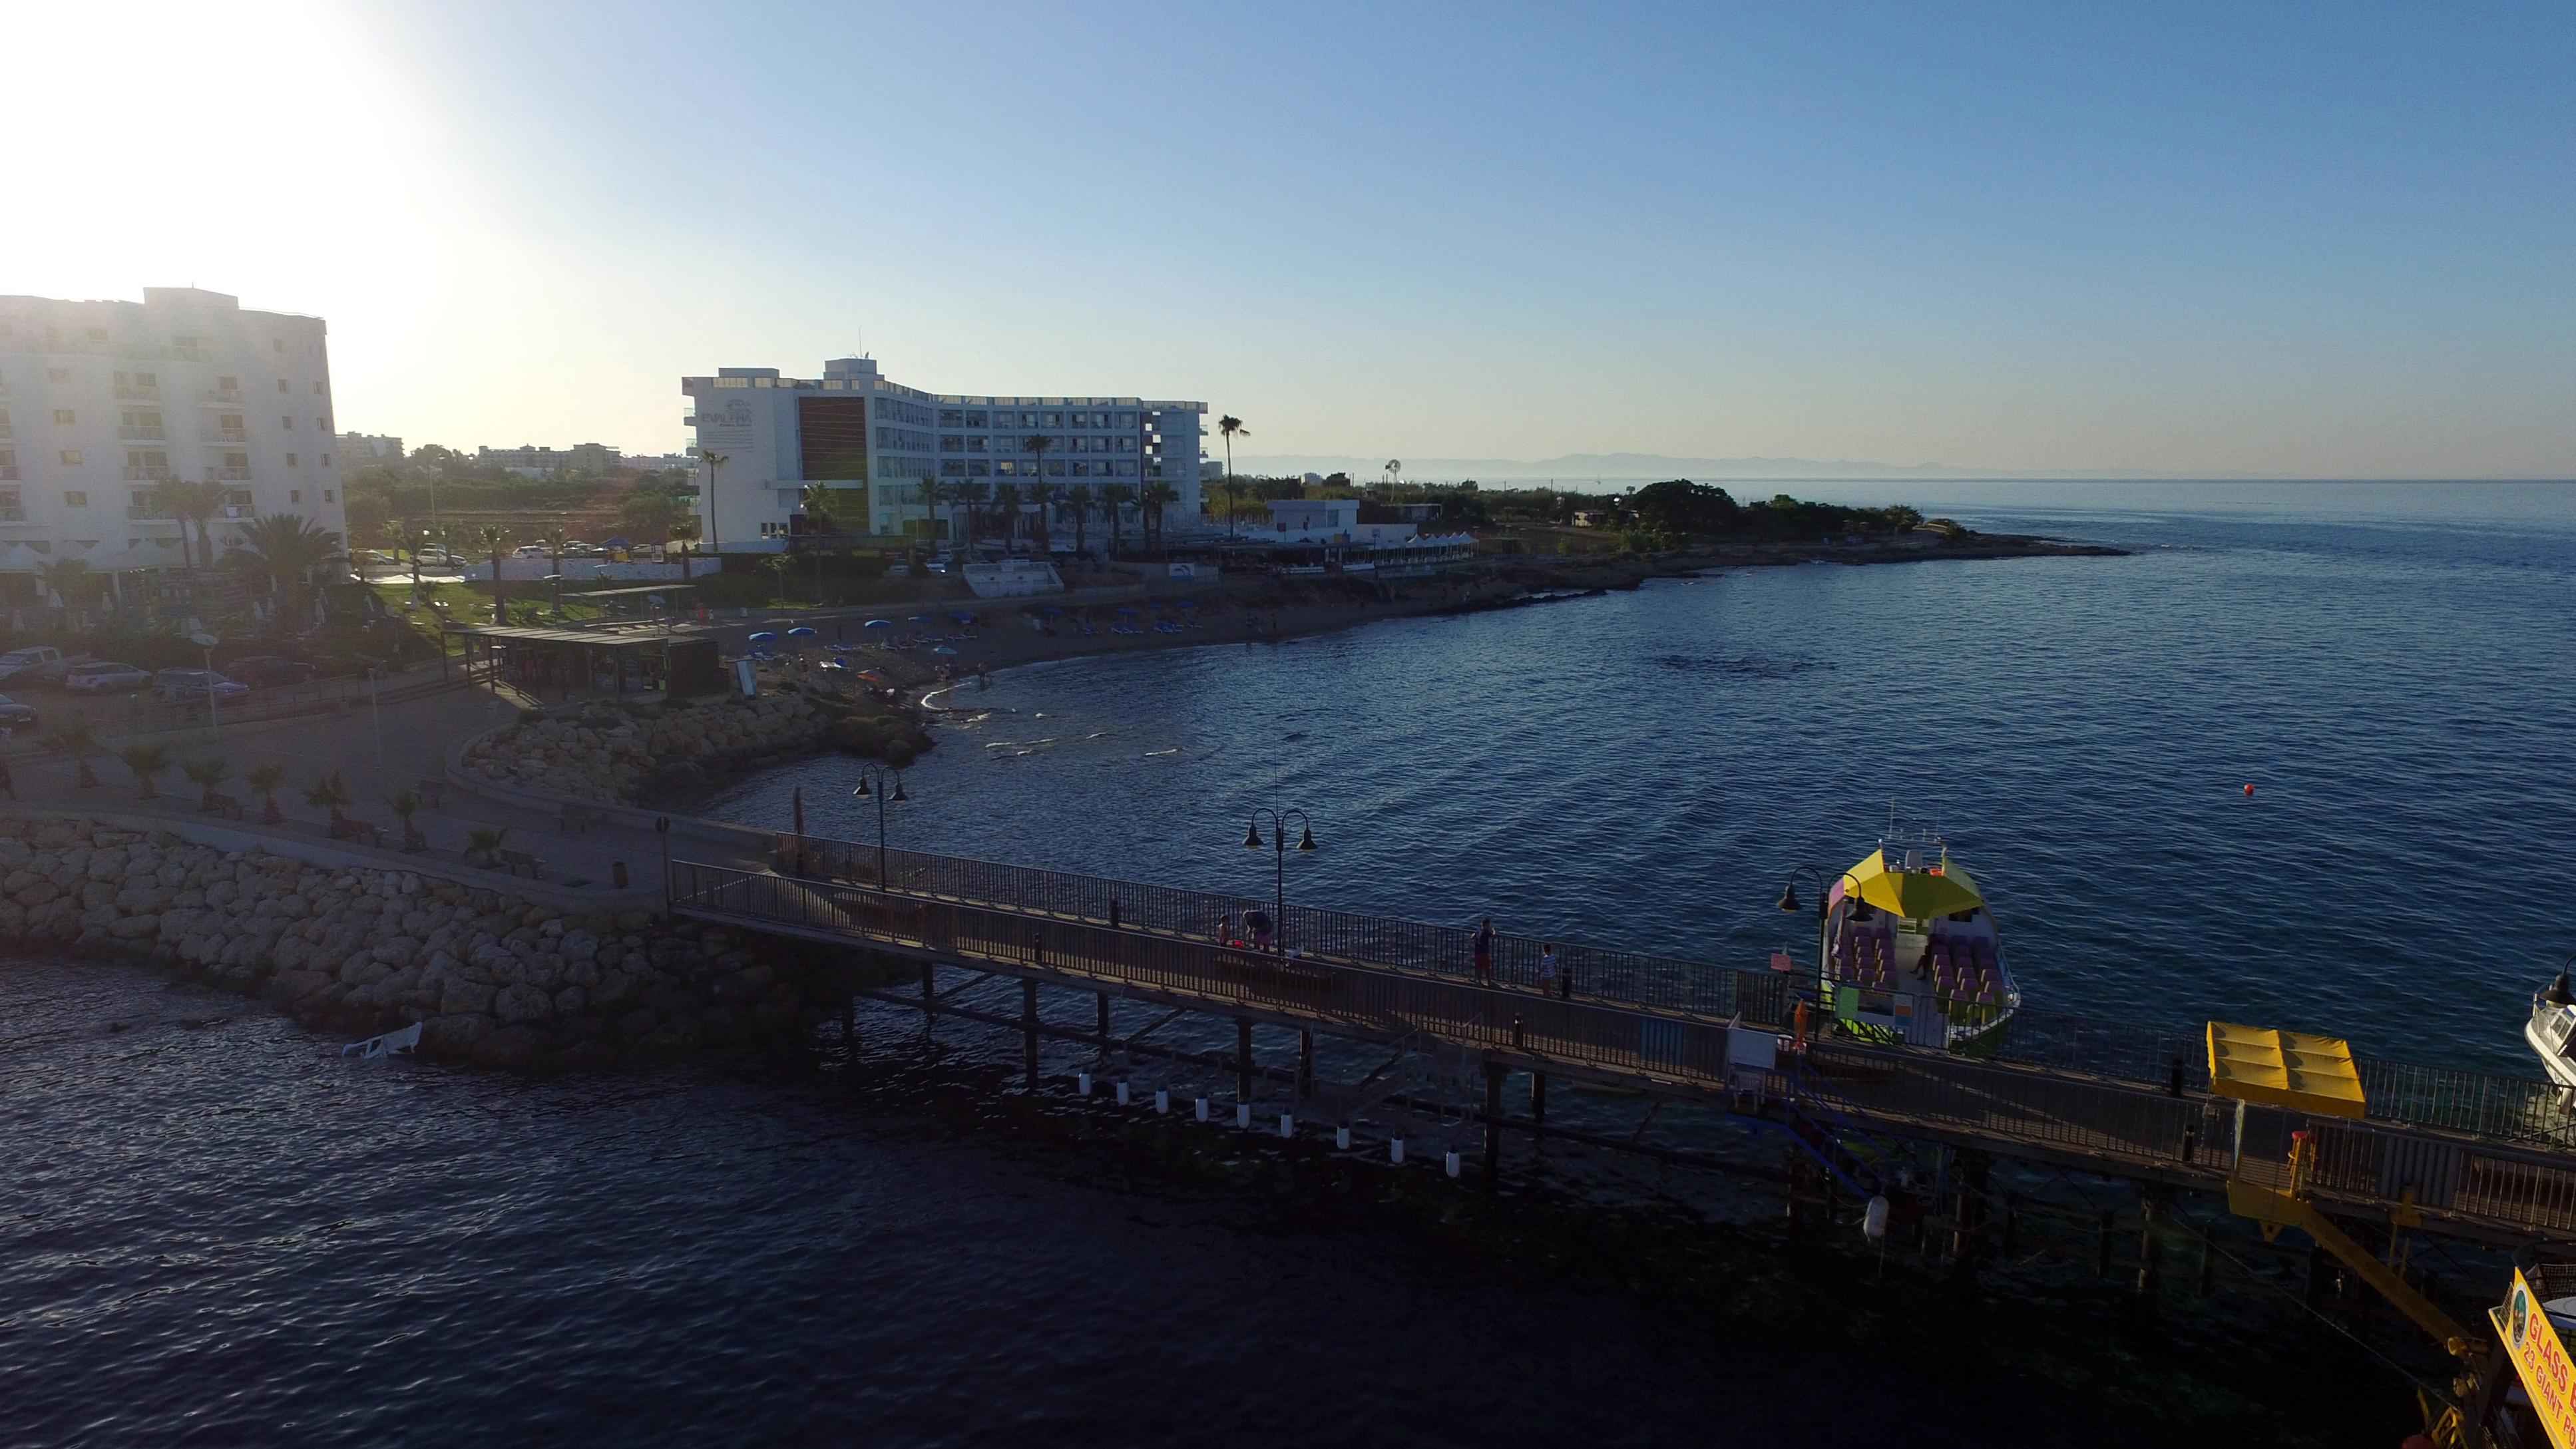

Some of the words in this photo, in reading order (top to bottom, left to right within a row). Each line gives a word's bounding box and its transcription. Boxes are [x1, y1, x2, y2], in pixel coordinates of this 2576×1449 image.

[2524, 1341, 2535, 1370] 23
[2537, 1365, 2563, 1420] GIANT
[2563, 1414, 2576, 1449] PO
[2529, 1313, 2568, 1392] GLASS
